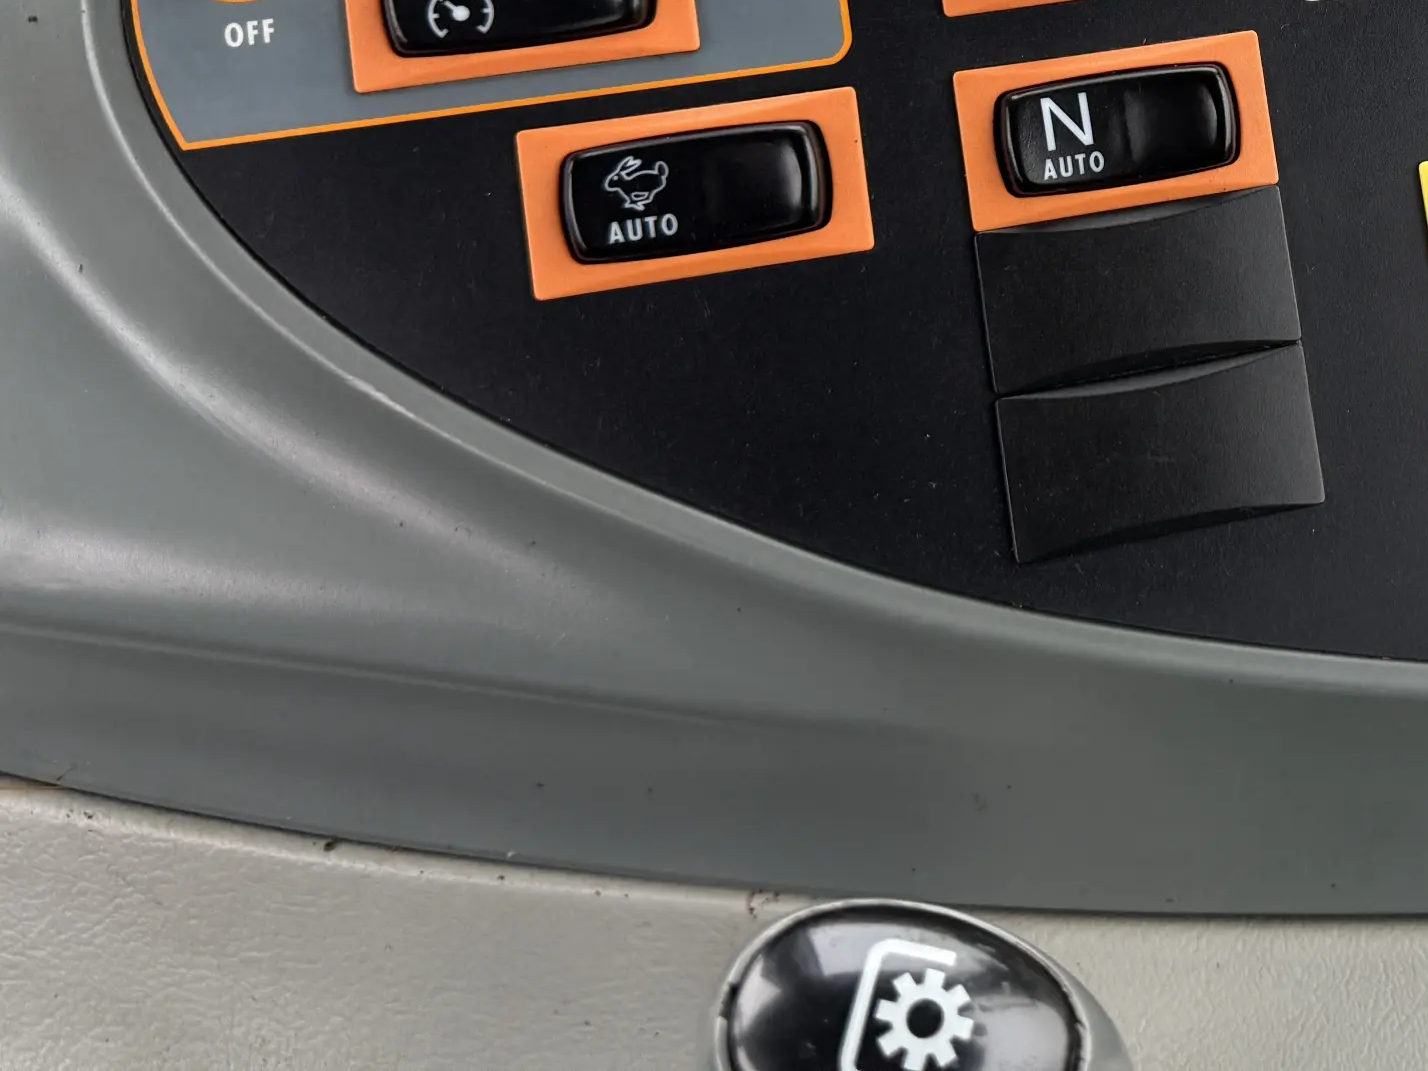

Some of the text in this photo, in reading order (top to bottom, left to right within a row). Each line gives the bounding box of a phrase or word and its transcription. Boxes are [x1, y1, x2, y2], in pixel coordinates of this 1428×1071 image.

[224, 19, 274, 48] OFF
[1040, 93, 1094, 151] N
[1043, 150, 1105, 181] AUTO
[609, 213, 678, 245] AUTO
